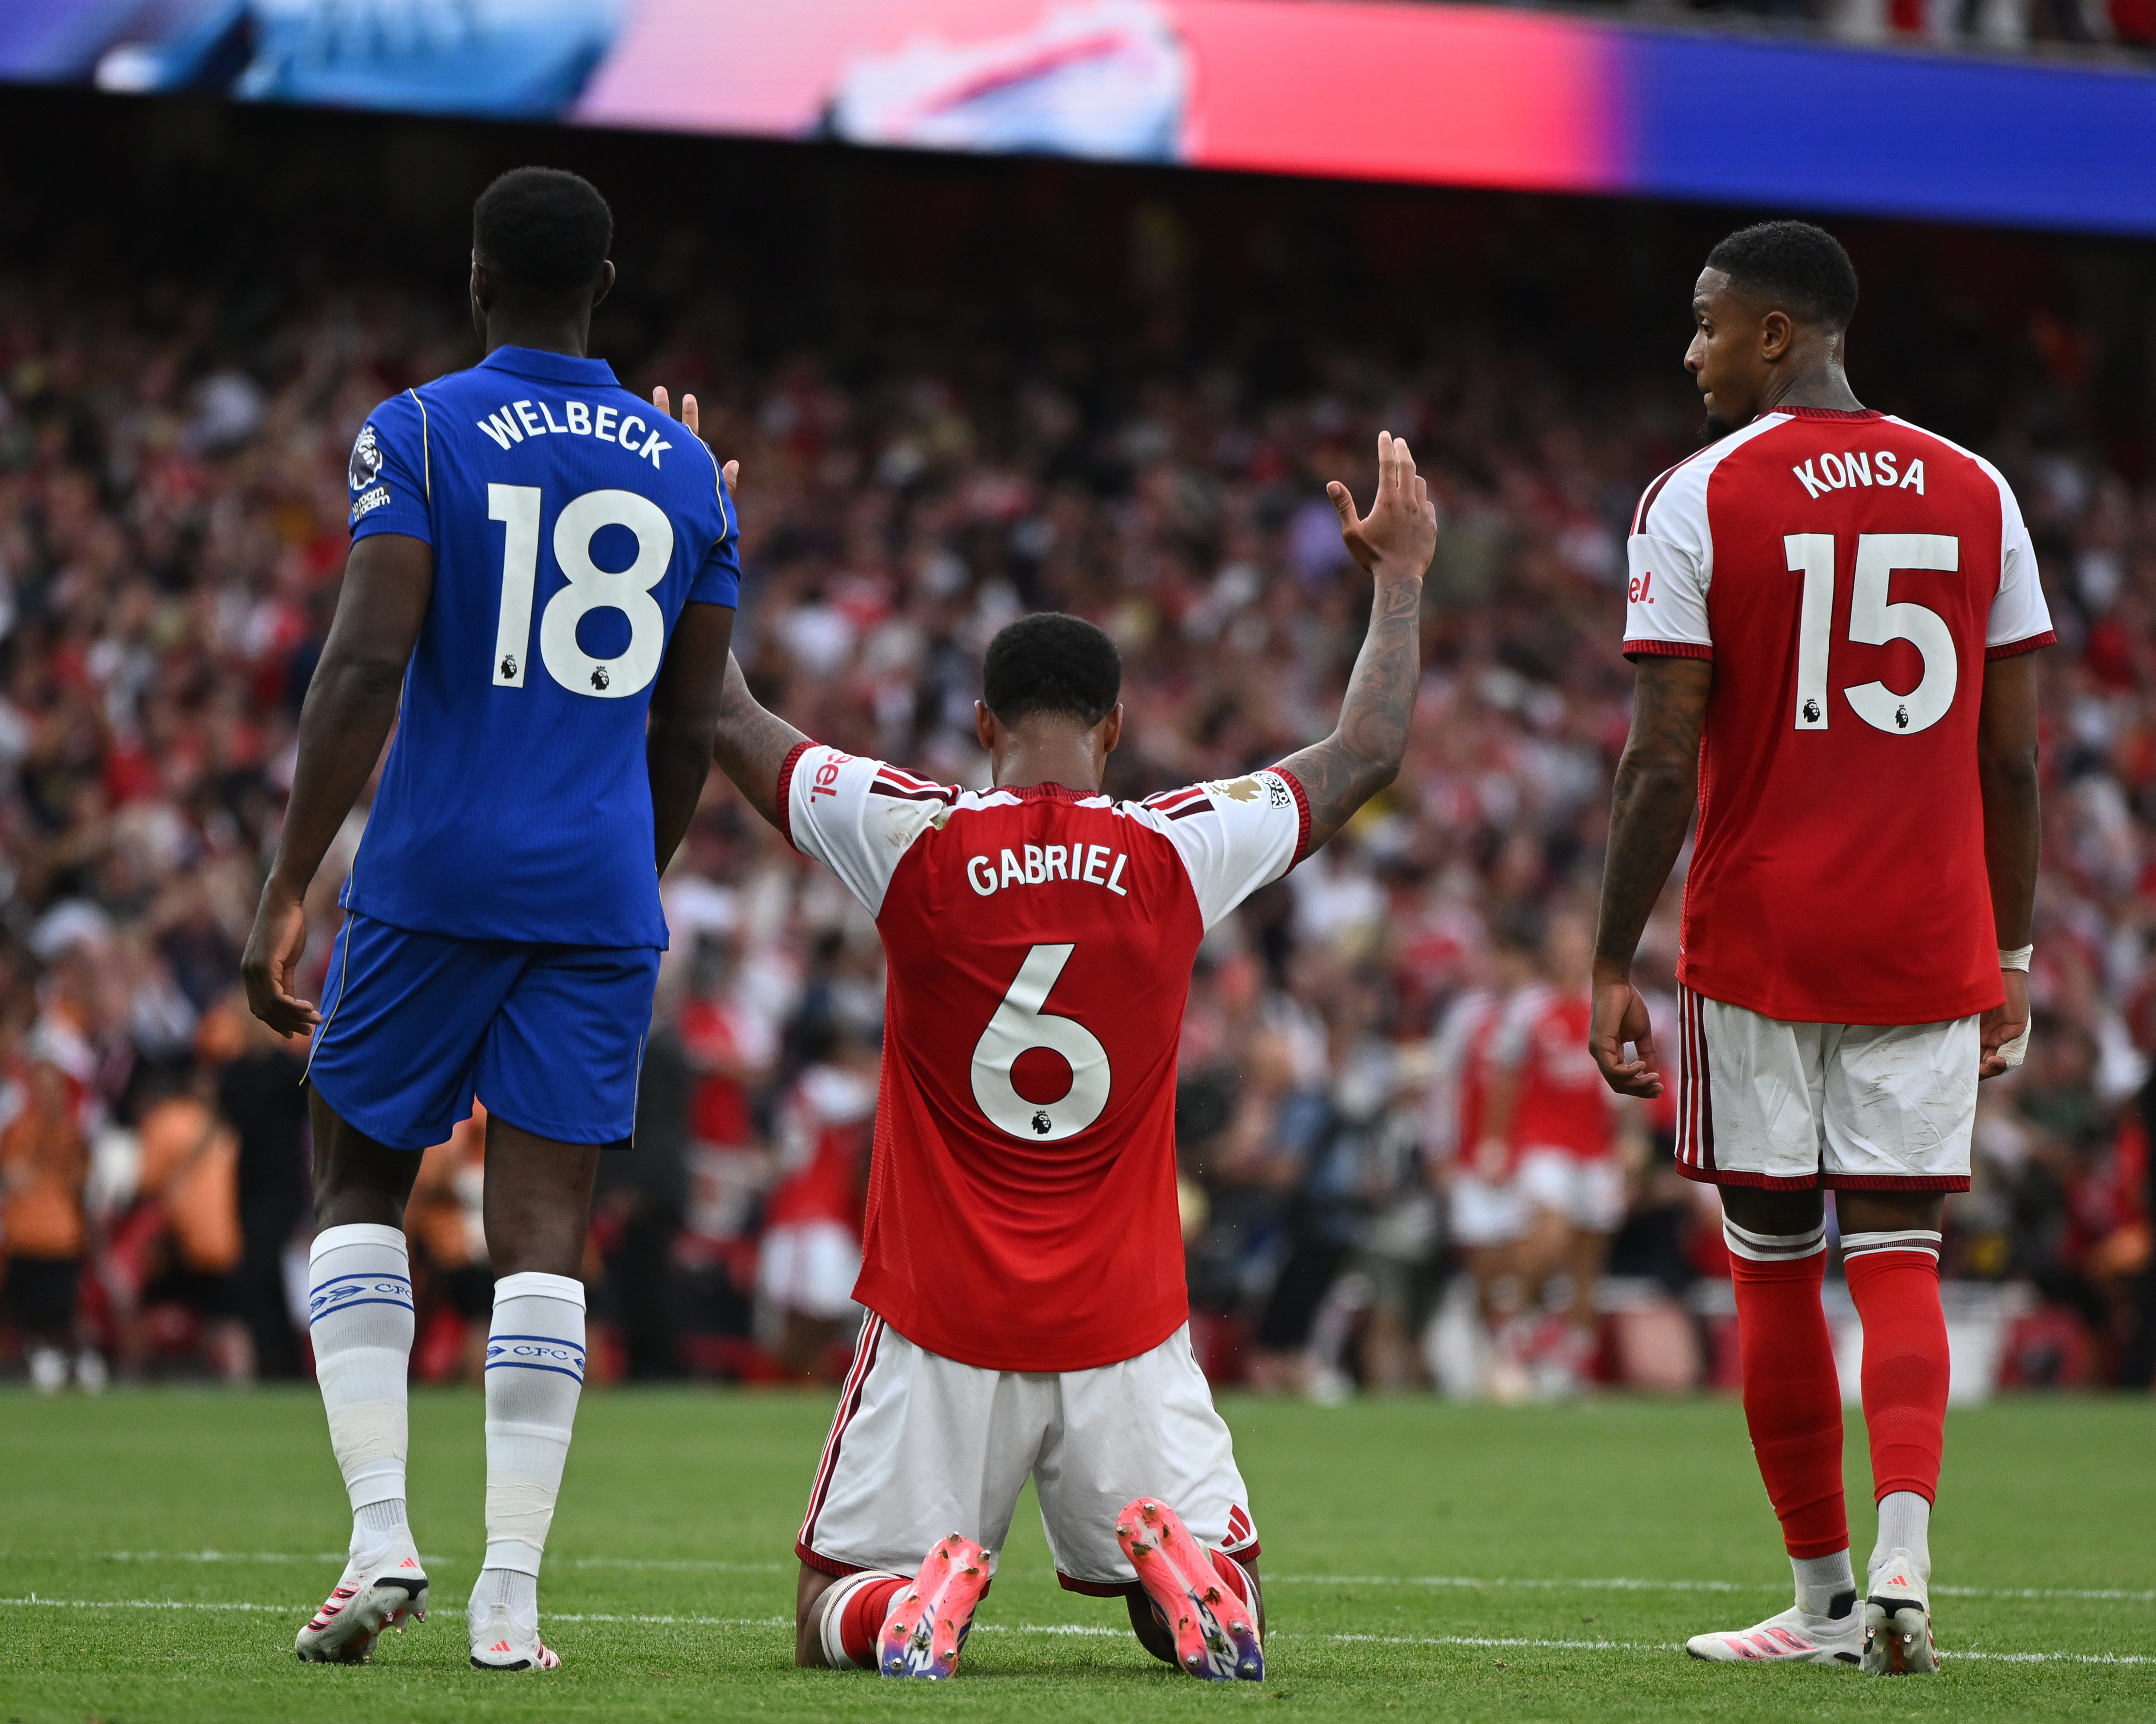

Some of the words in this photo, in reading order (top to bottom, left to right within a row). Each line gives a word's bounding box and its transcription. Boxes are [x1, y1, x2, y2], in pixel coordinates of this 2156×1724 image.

[476, 400, 672, 469] WELBECK
[358, 486, 384, 509] room
[1793, 451, 1924, 499] KONSA
[488, 483, 673, 698] 18
[1783, 533, 1959, 735] 15
[968, 843, 1127, 896] GABRIEL
[971, 944, 1111, 1141] 6
[514, 1346, 568, 1360] CFC
